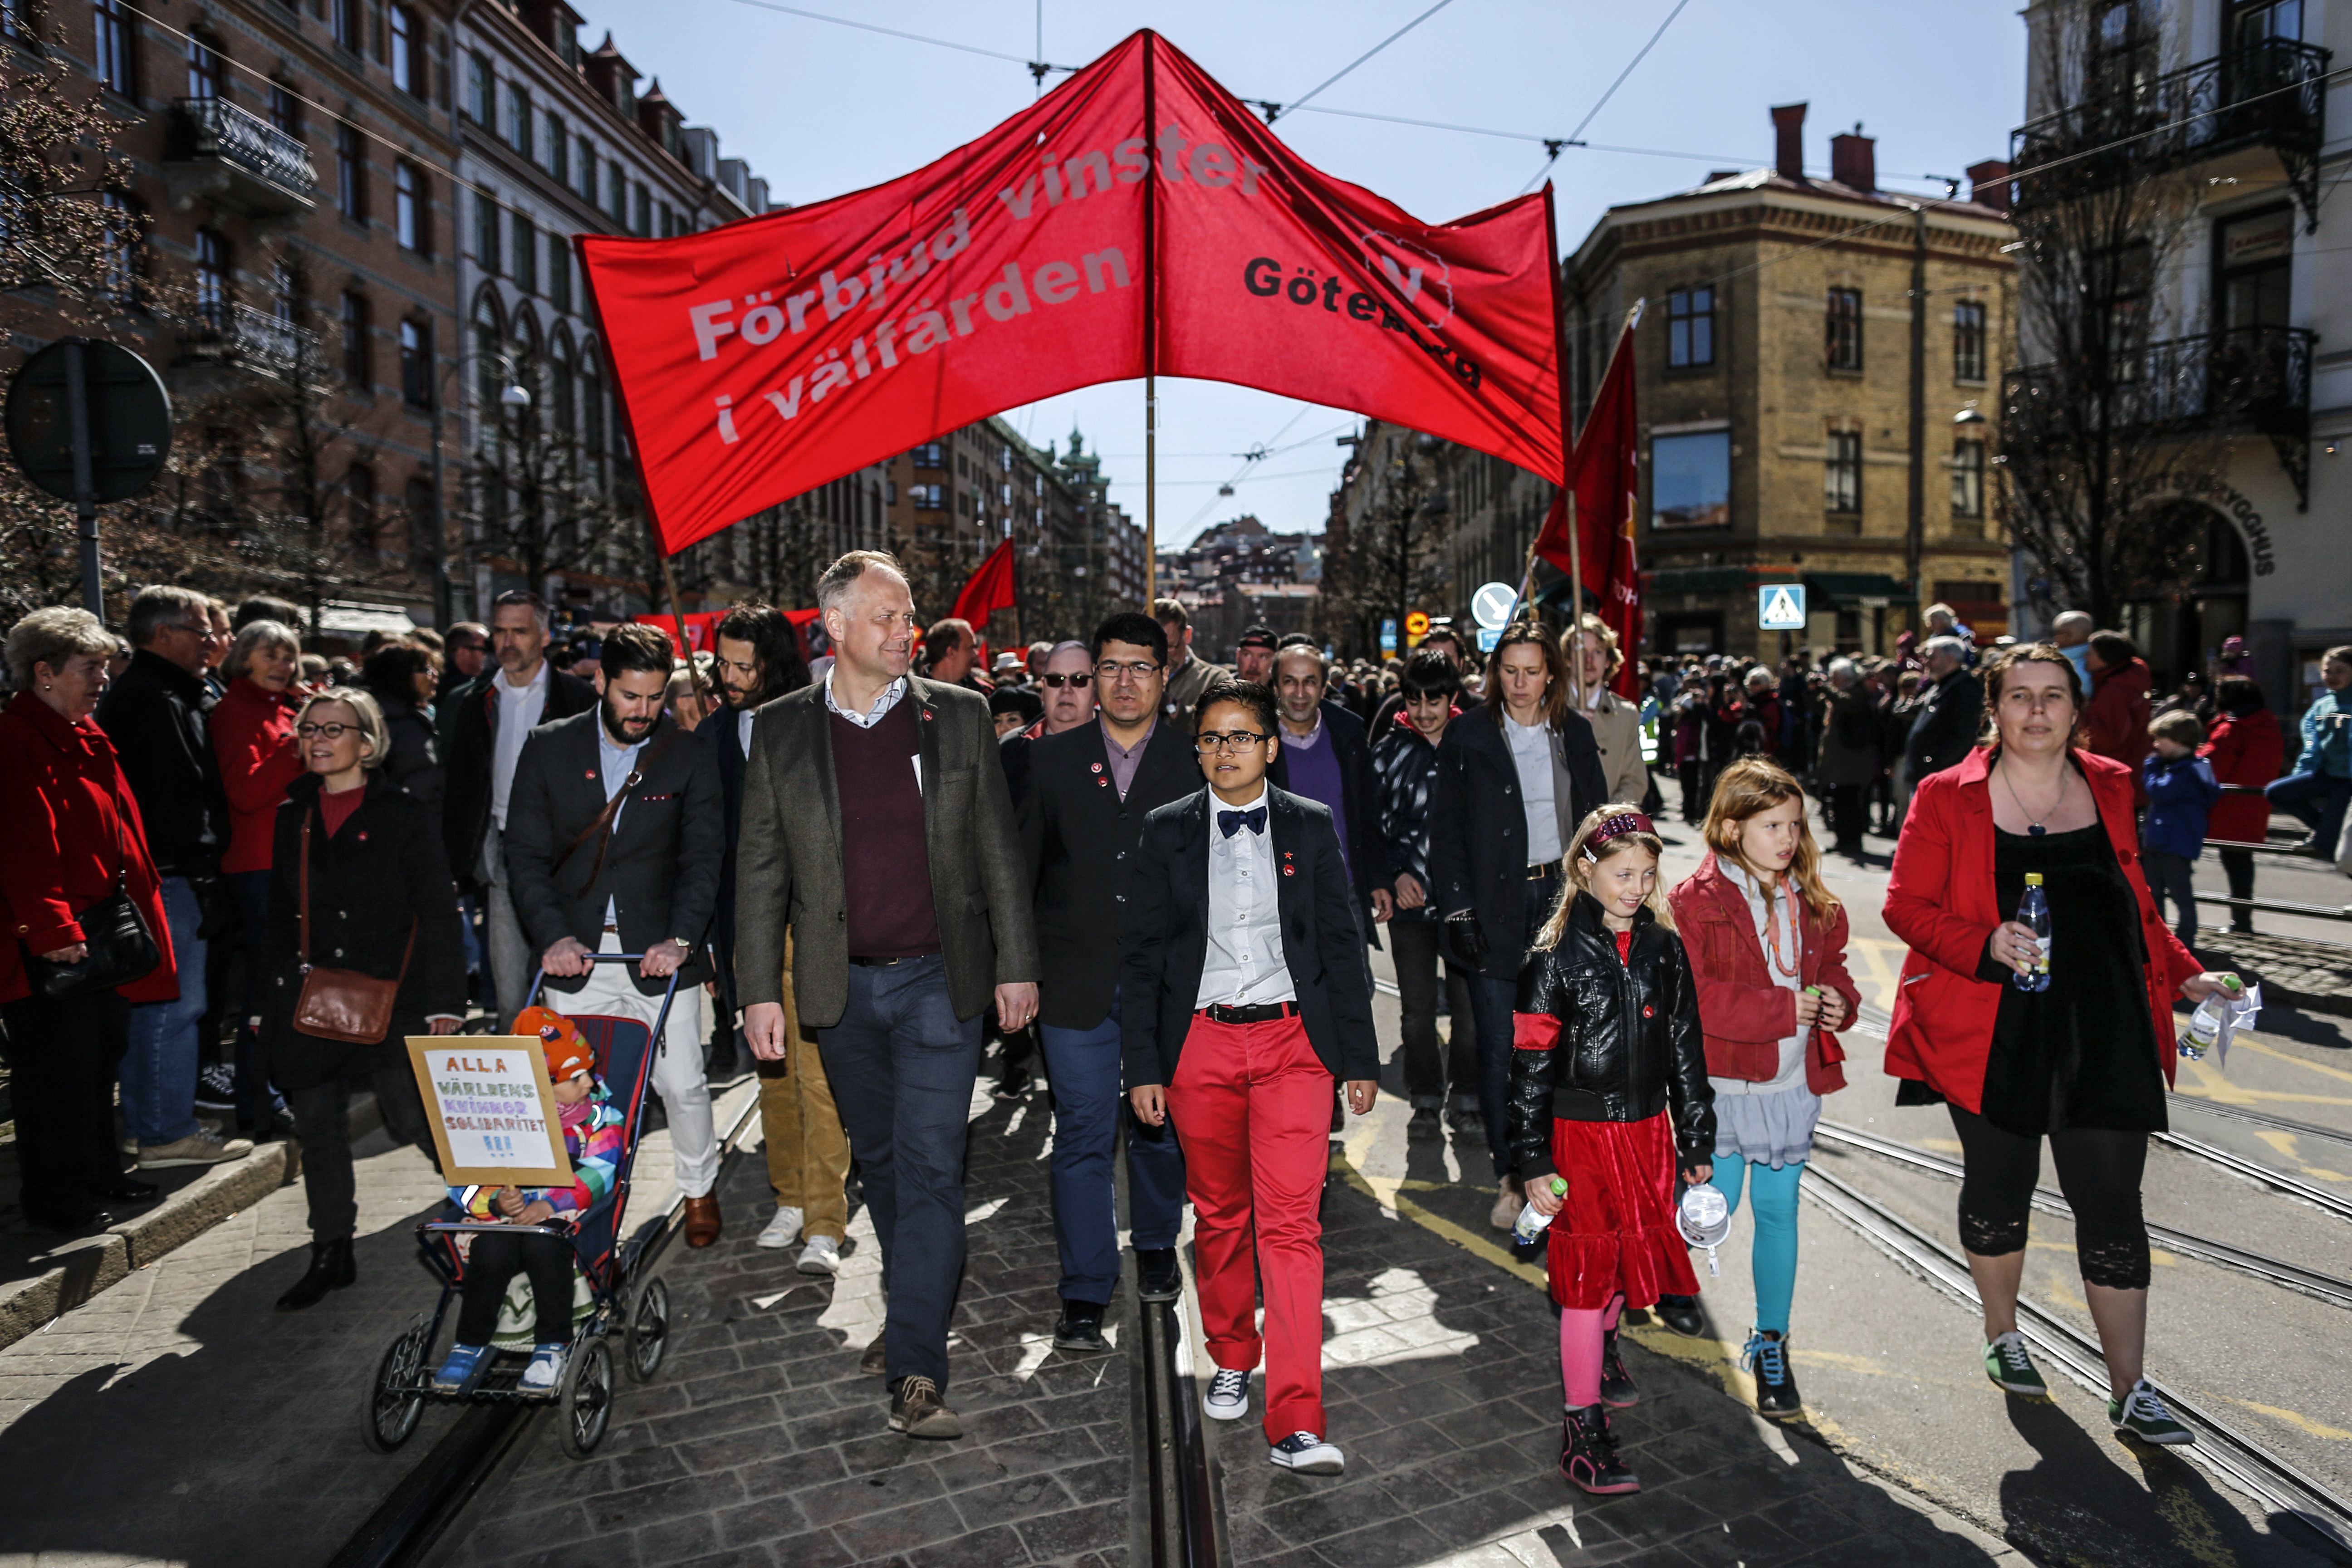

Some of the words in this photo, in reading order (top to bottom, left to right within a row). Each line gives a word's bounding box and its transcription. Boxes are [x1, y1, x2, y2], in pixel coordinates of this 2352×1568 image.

[689, 207, 971, 362] Förbjud
[998, 122, 1269, 220] vinster
[715, 394, 740, 445] i
[764, 246, 1131, 421] välfärden
[446, 1057, 508, 1073] ALLA
[436, 1078, 535, 1098] VÄRLDENS
[443, 1097, 528, 1115] KVINNOR
[445, 1115, 545, 1132] SOLIDARITET
